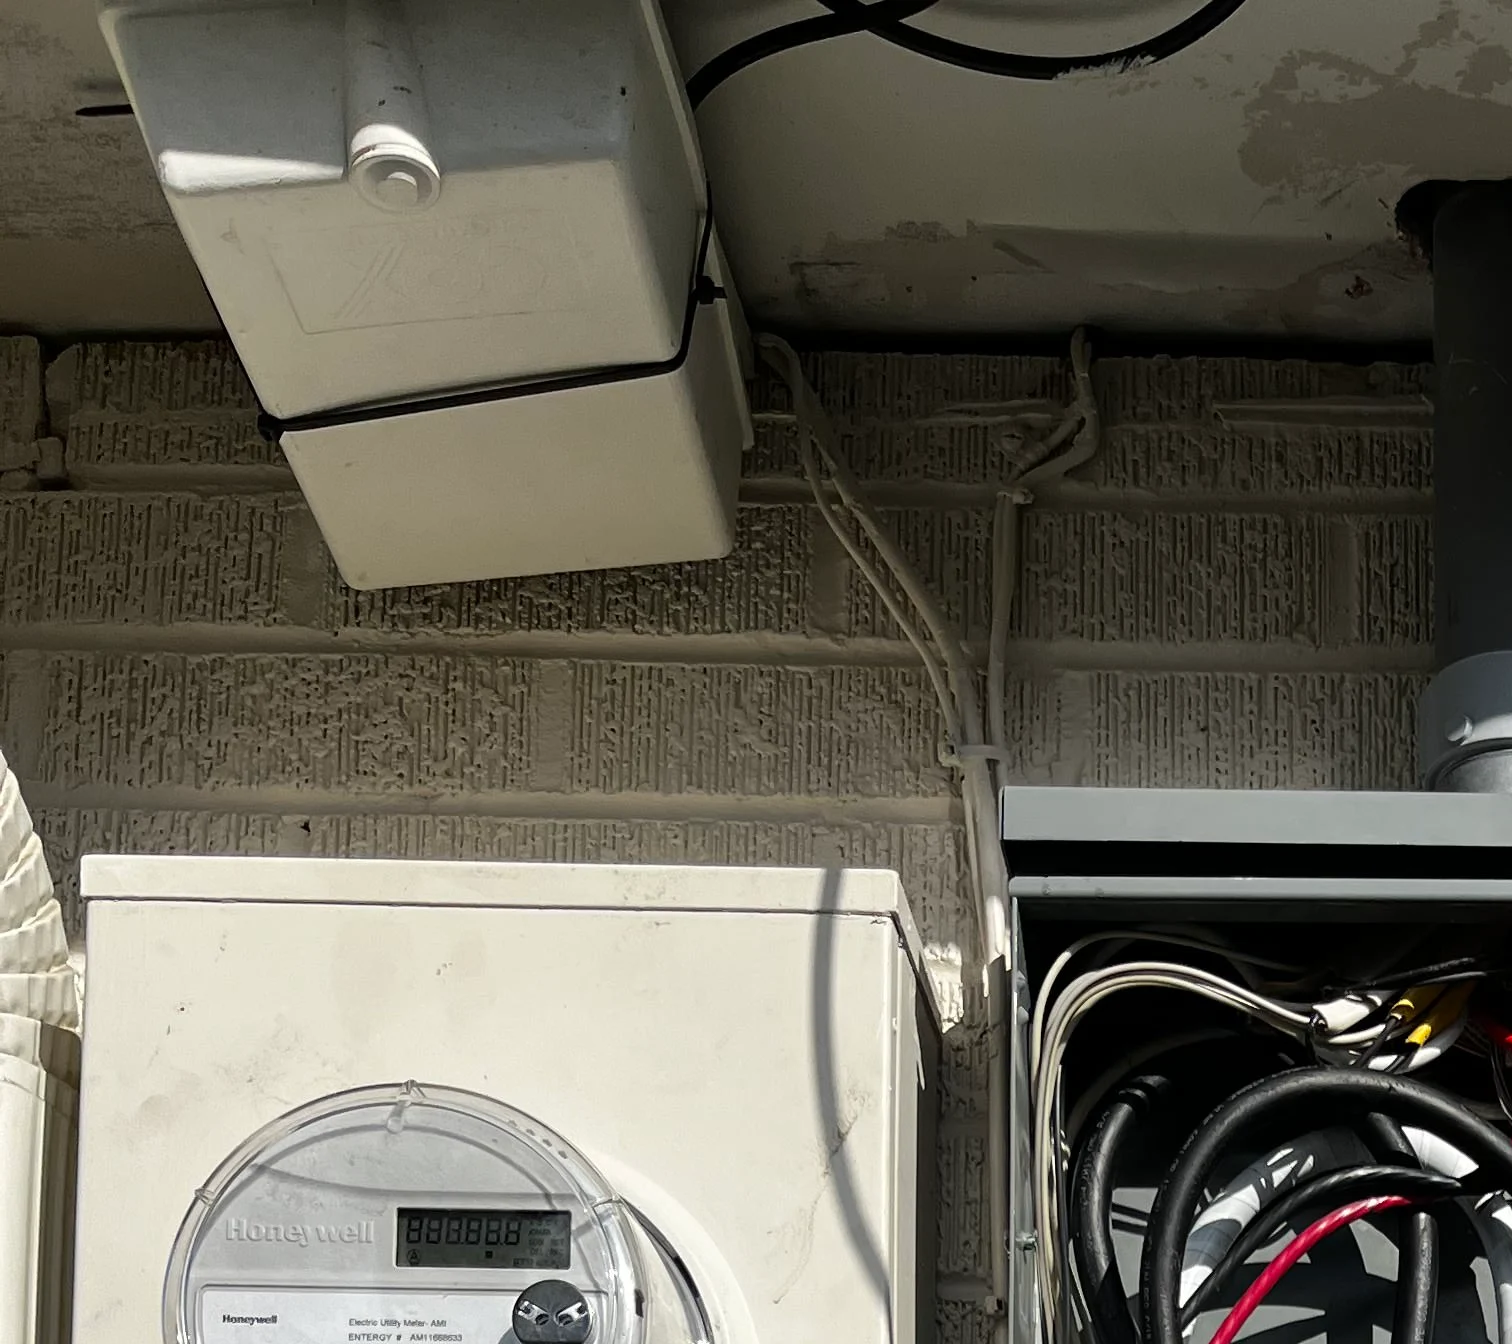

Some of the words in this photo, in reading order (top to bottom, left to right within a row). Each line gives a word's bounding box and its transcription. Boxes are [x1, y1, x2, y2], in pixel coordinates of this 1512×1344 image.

[225, 1218, 374, 1248] Honeywell
[222, 1314, 278, 1325] Honeywell
[349, 1318, 378, 1326] Electric
[380, 1319, 400, 1328] Utility
[348, 1333, 392, 1341] ENTERGY
